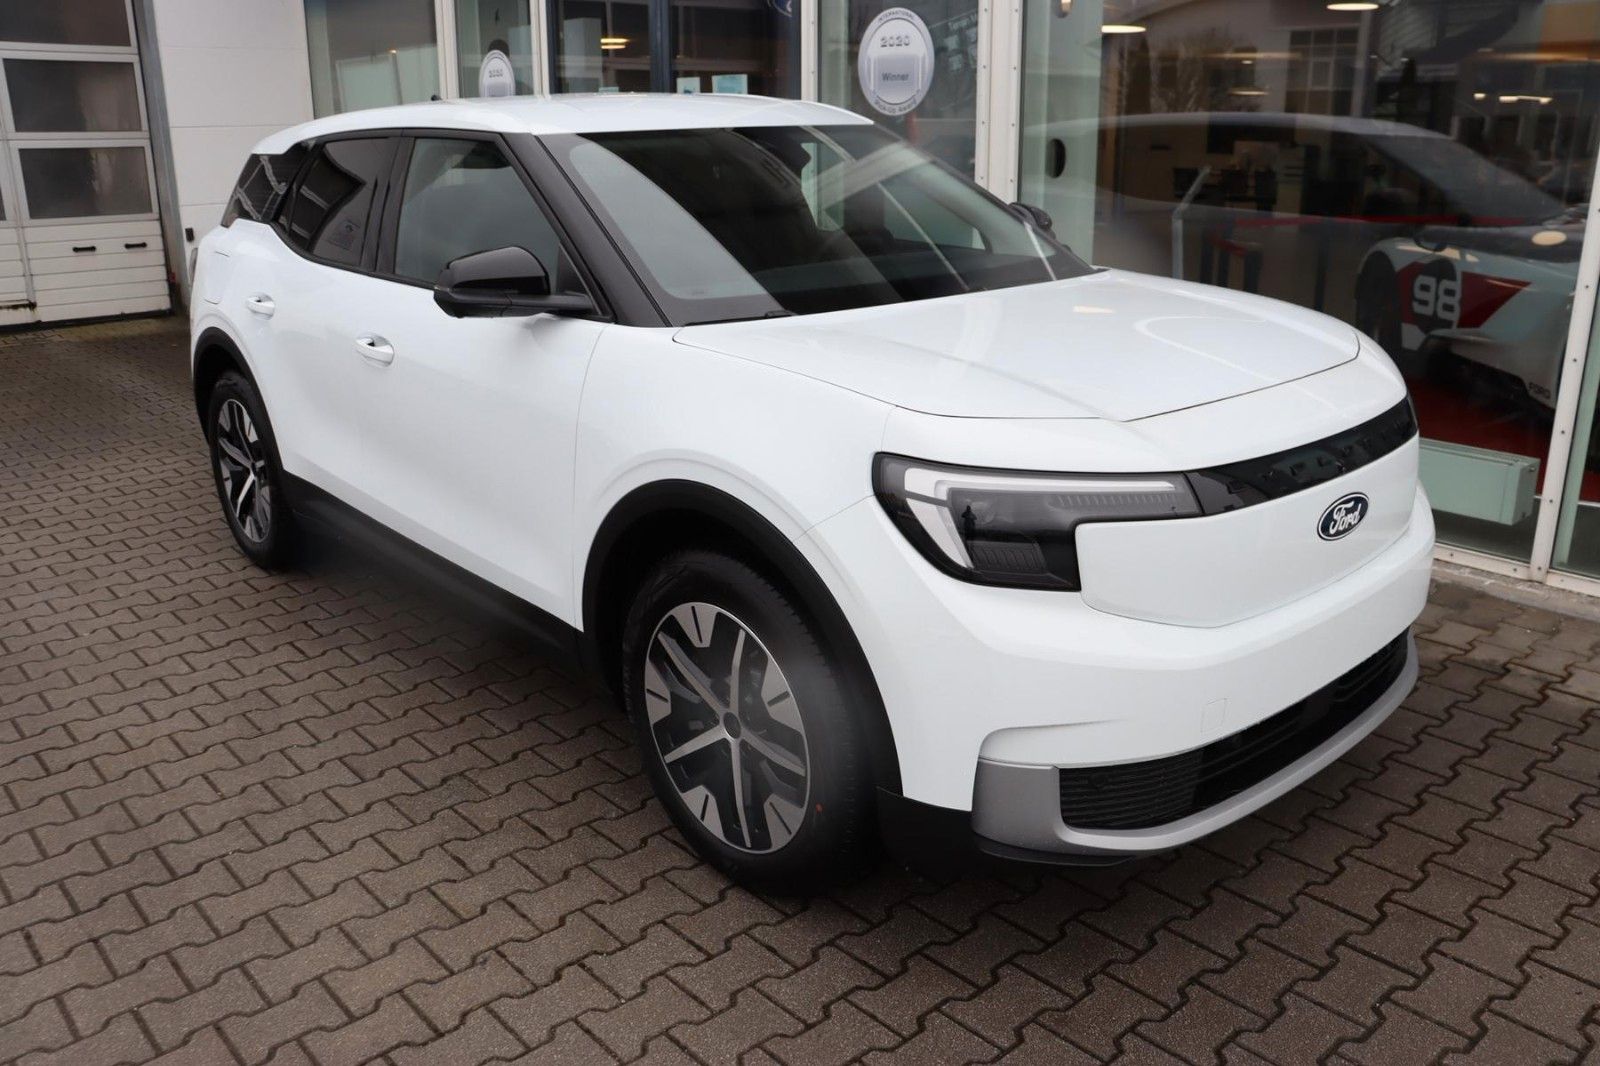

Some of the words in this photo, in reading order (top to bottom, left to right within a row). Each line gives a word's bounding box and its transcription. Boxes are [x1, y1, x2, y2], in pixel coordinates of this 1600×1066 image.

[880, 36, 910, 48] 2020
[881, 72, 909, 81] Winner
[1412, 274, 1461, 321] 98
[1329, 500, 1362, 535] Ford
